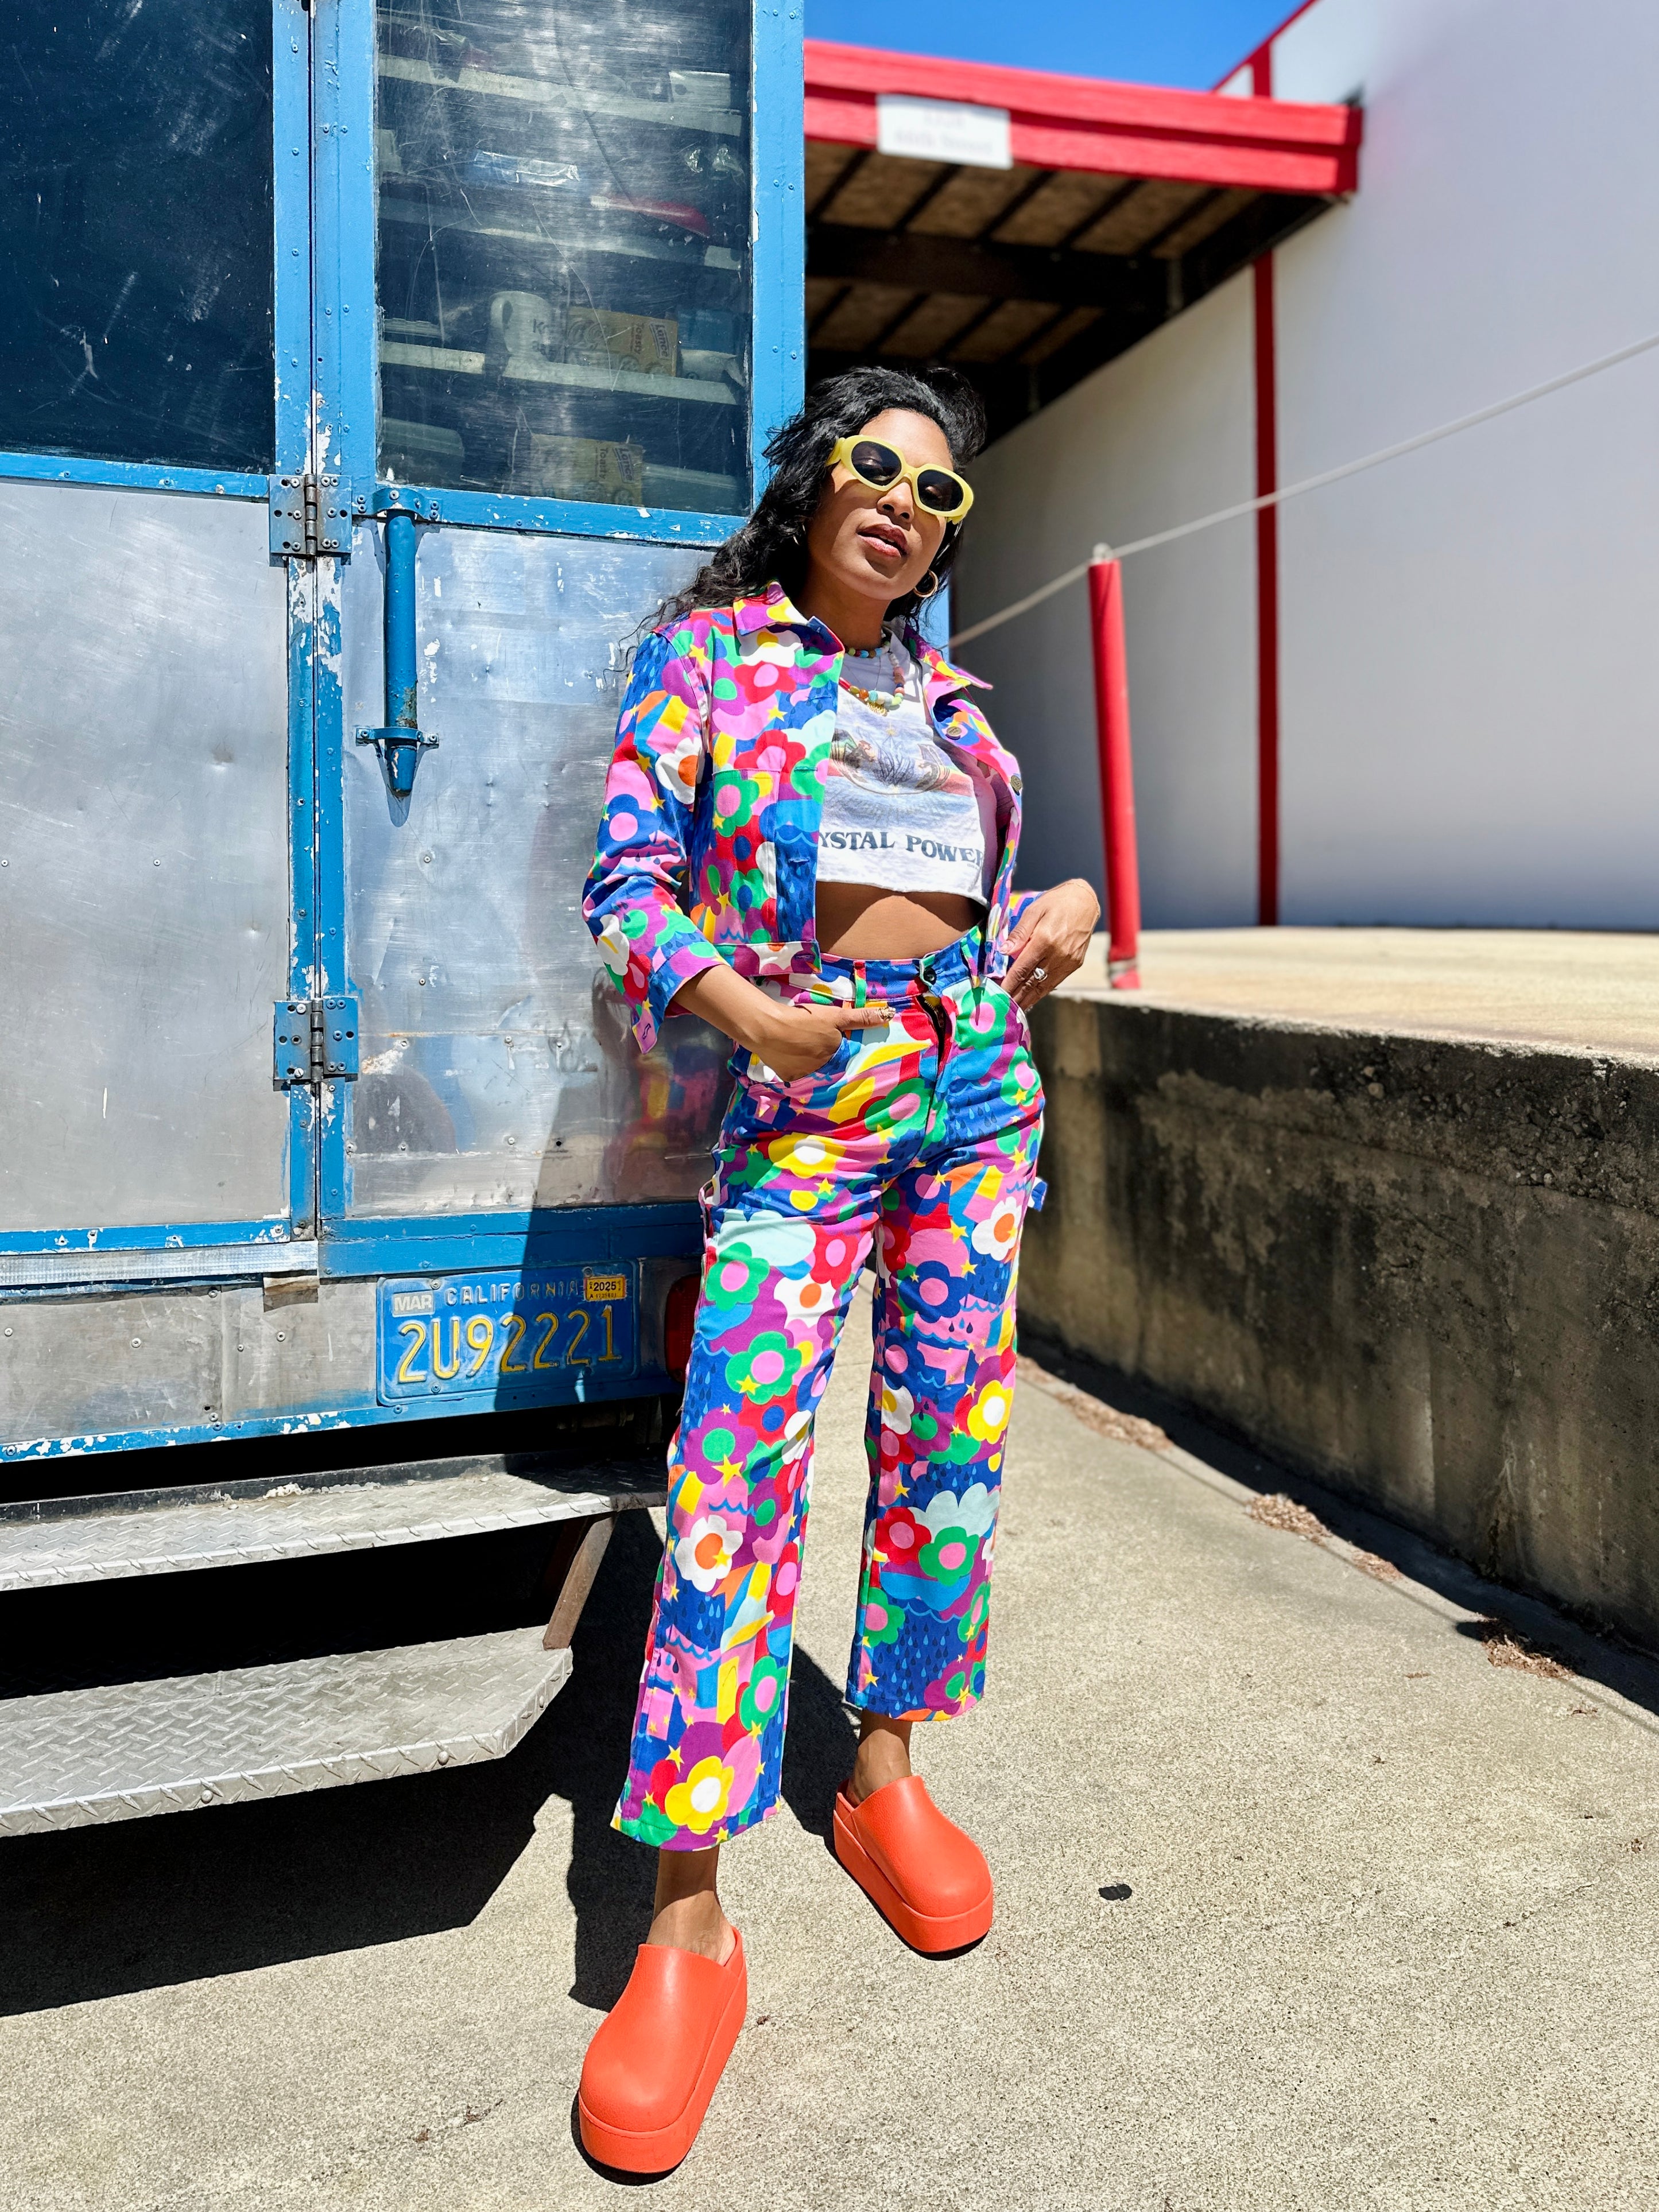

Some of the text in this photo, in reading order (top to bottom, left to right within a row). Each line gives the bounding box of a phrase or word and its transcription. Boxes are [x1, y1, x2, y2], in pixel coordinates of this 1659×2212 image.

[655, 324, 669, 357] Lance
[619, 447, 633, 482] Lance
[819, 832, 895, 849] YSTAL
[445, 1280, 579, 1306] CALIFORNIA
[594, 1281, 617, 1291] 2025
[394, 1295, 432, 1311] MAR
[399, 1305, 622, 1384] 2U92221
